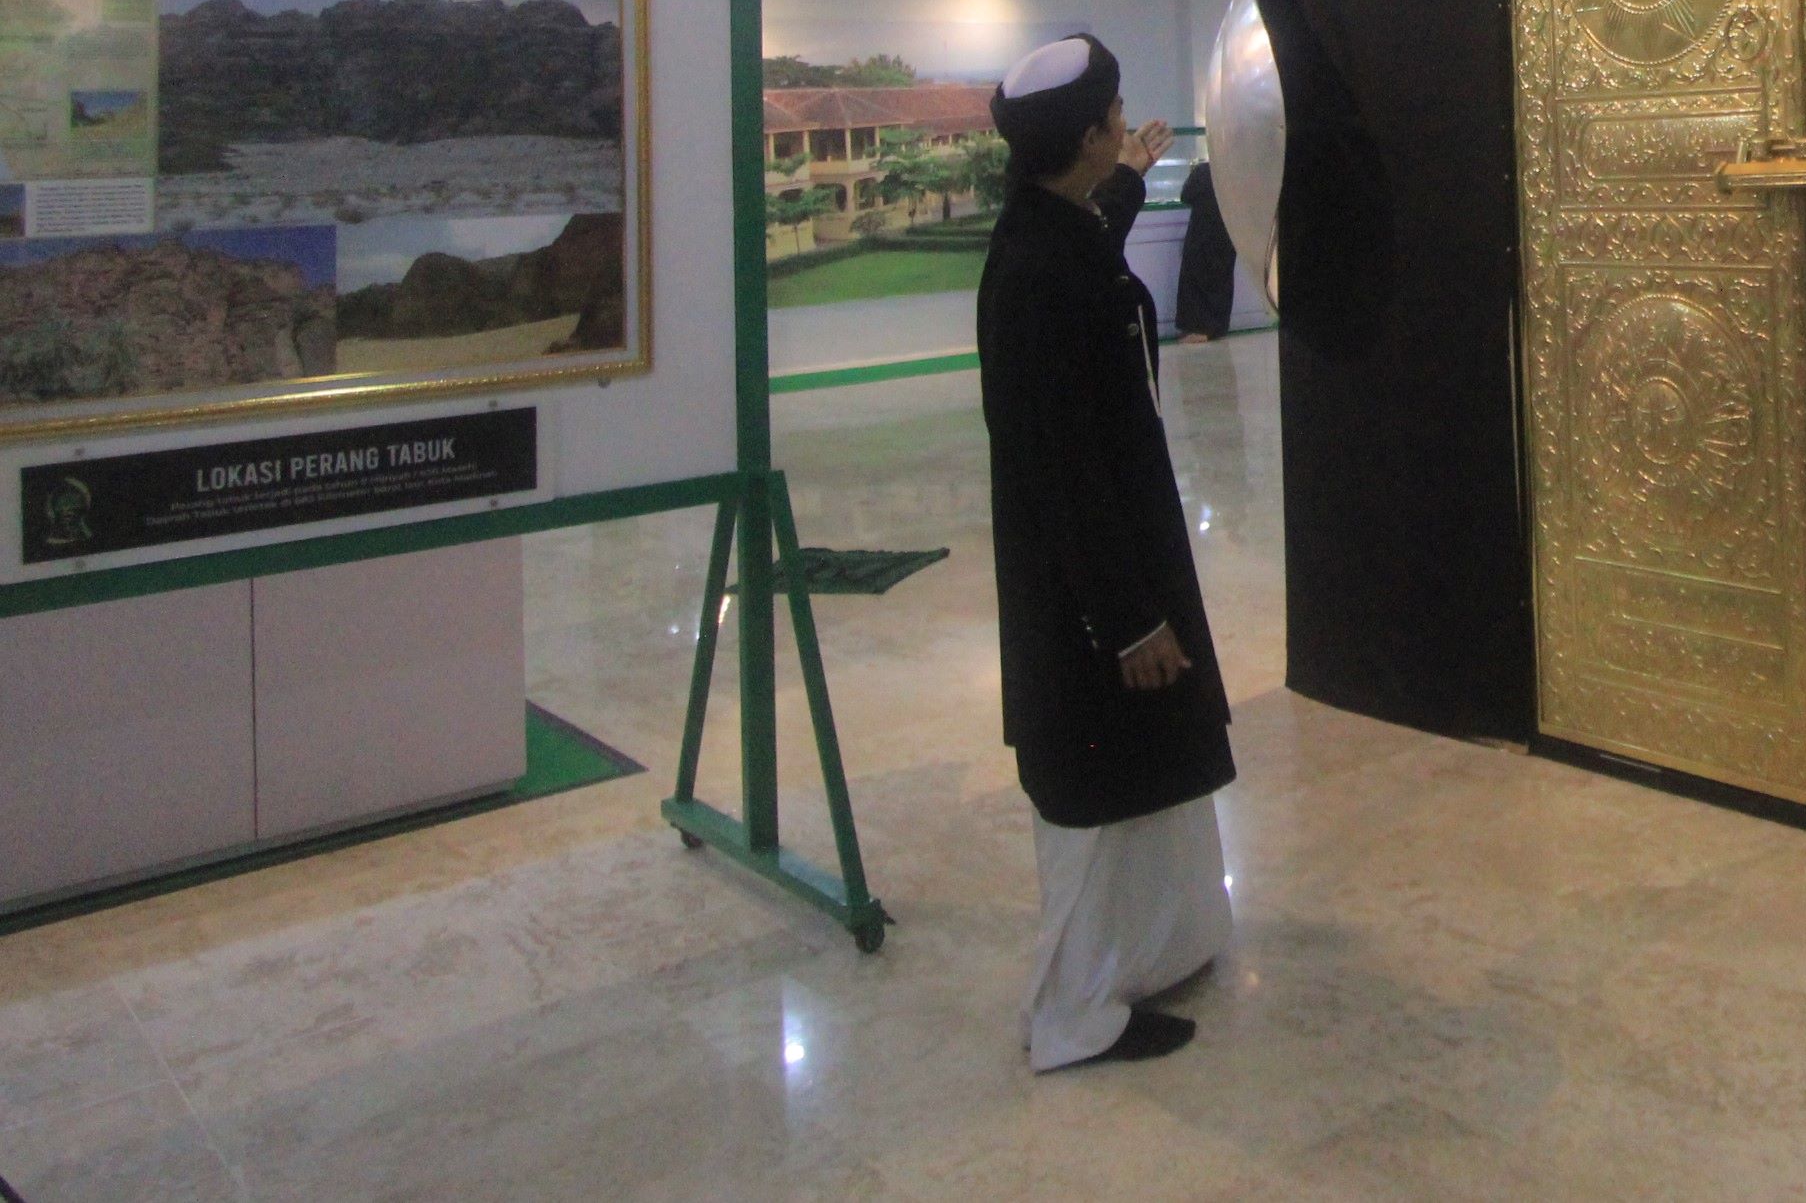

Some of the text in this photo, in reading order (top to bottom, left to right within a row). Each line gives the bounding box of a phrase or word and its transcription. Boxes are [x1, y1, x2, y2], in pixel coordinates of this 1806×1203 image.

[195, 437, 457, 492] LOKASI PERANG TABUK
